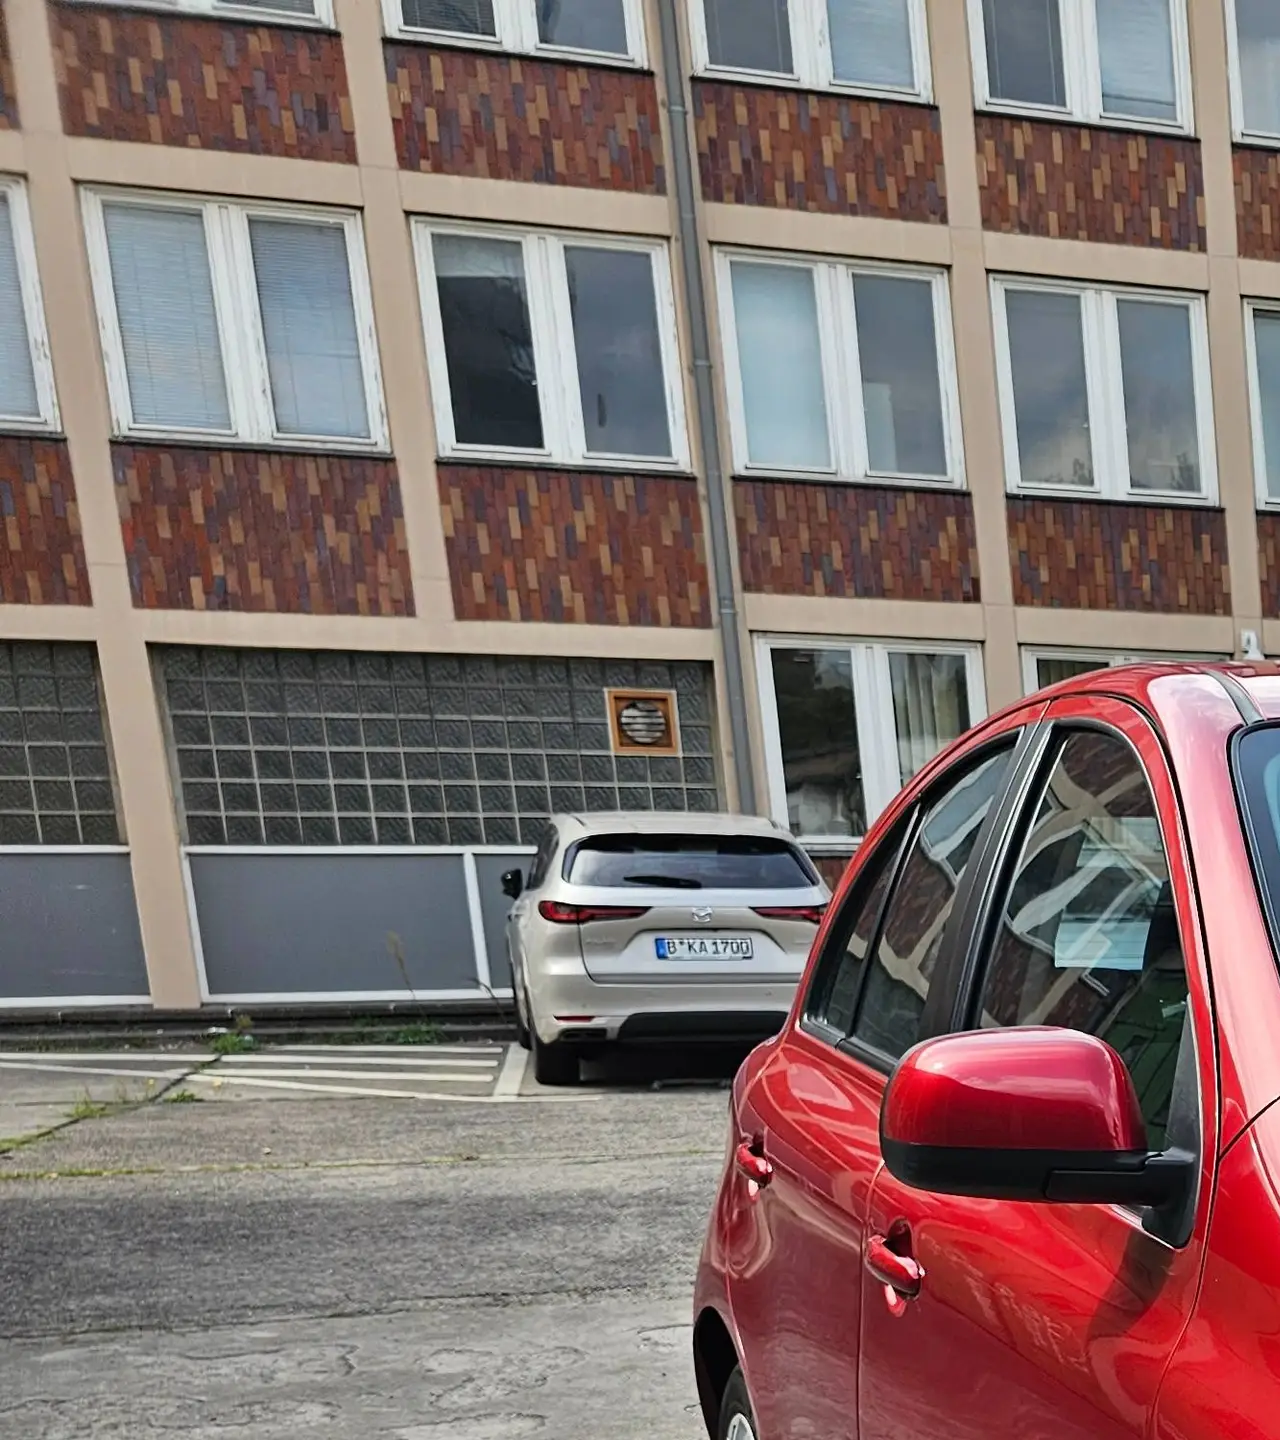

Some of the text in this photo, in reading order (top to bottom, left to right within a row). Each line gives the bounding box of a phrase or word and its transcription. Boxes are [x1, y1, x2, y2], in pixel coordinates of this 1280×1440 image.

[666, 940, 750, 955] B KA 1700
